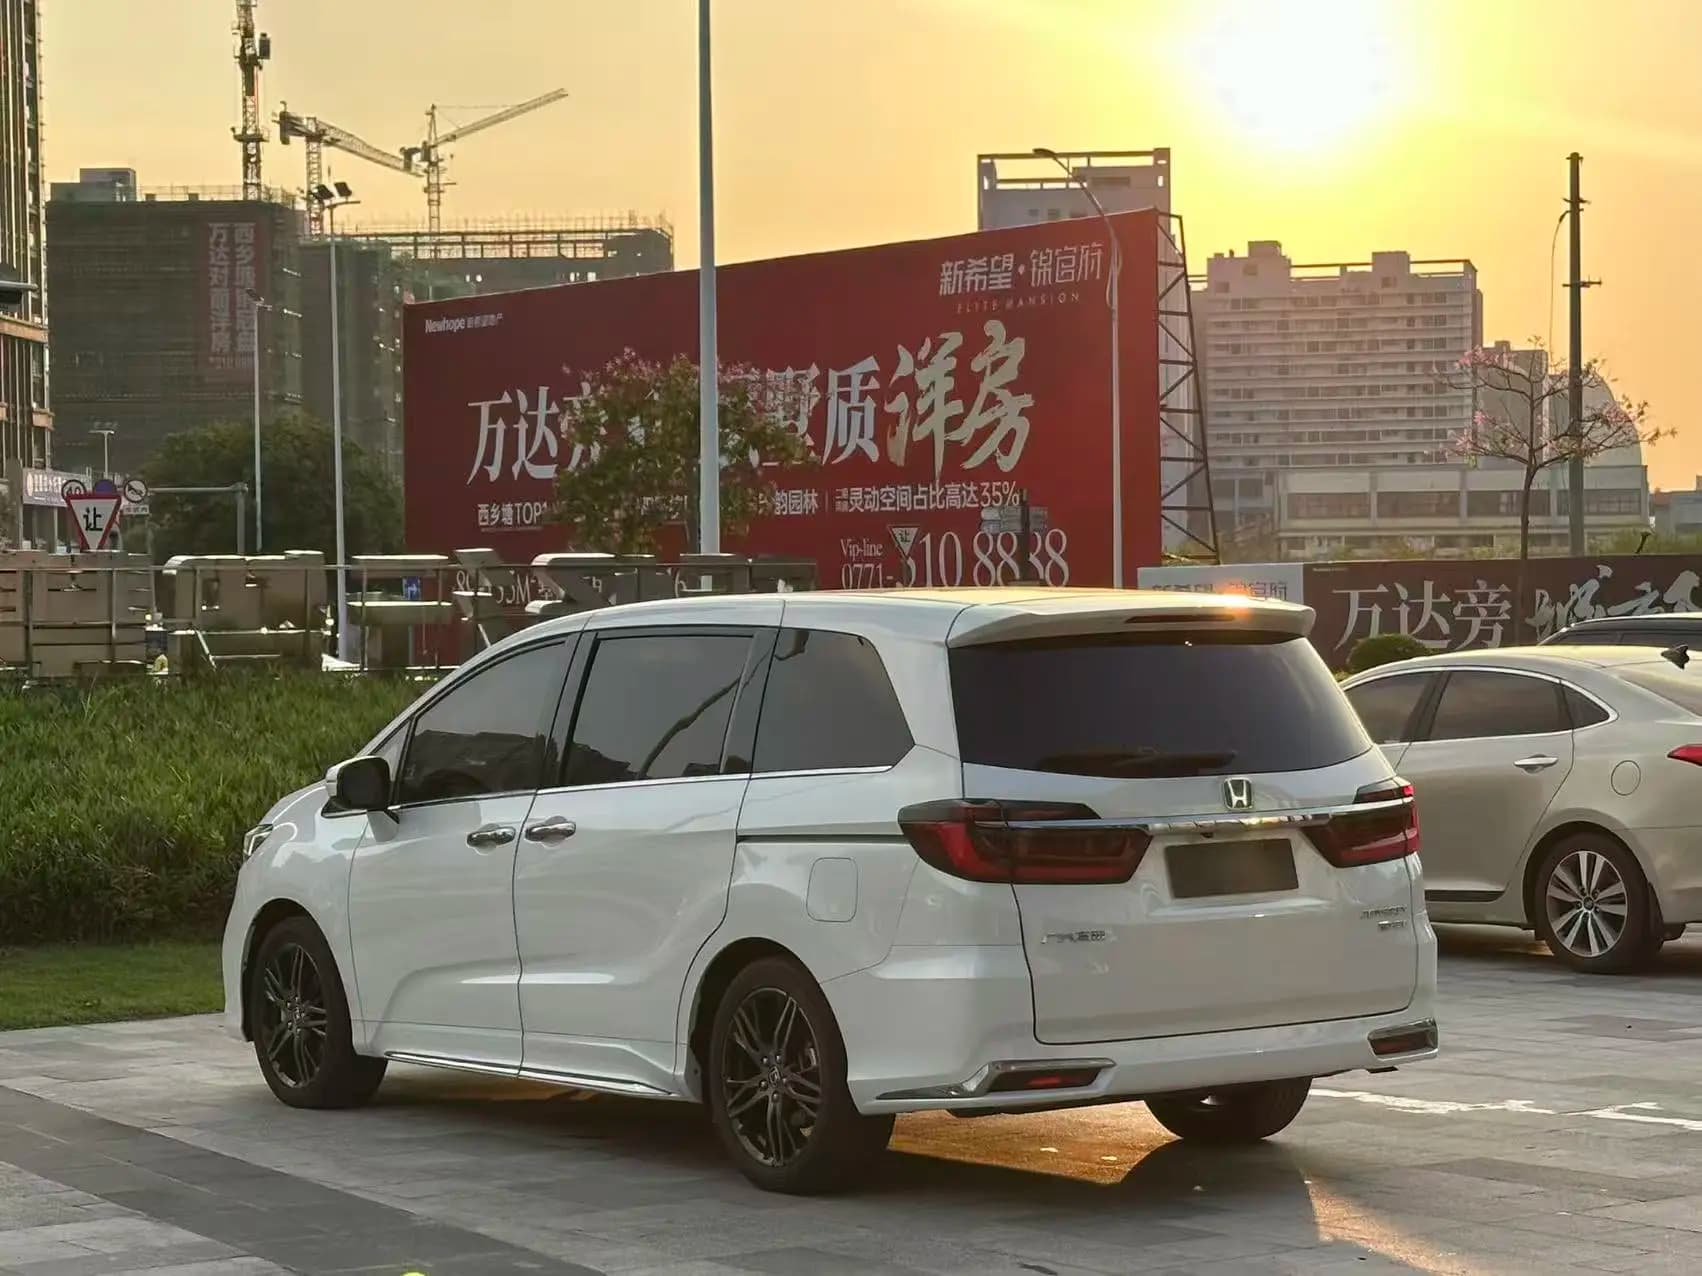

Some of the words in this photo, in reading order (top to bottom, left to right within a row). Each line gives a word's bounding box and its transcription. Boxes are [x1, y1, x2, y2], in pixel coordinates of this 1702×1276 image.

[83, 506, 104, 532] 让
[1332, 578, 1512, 651] 万达旁
